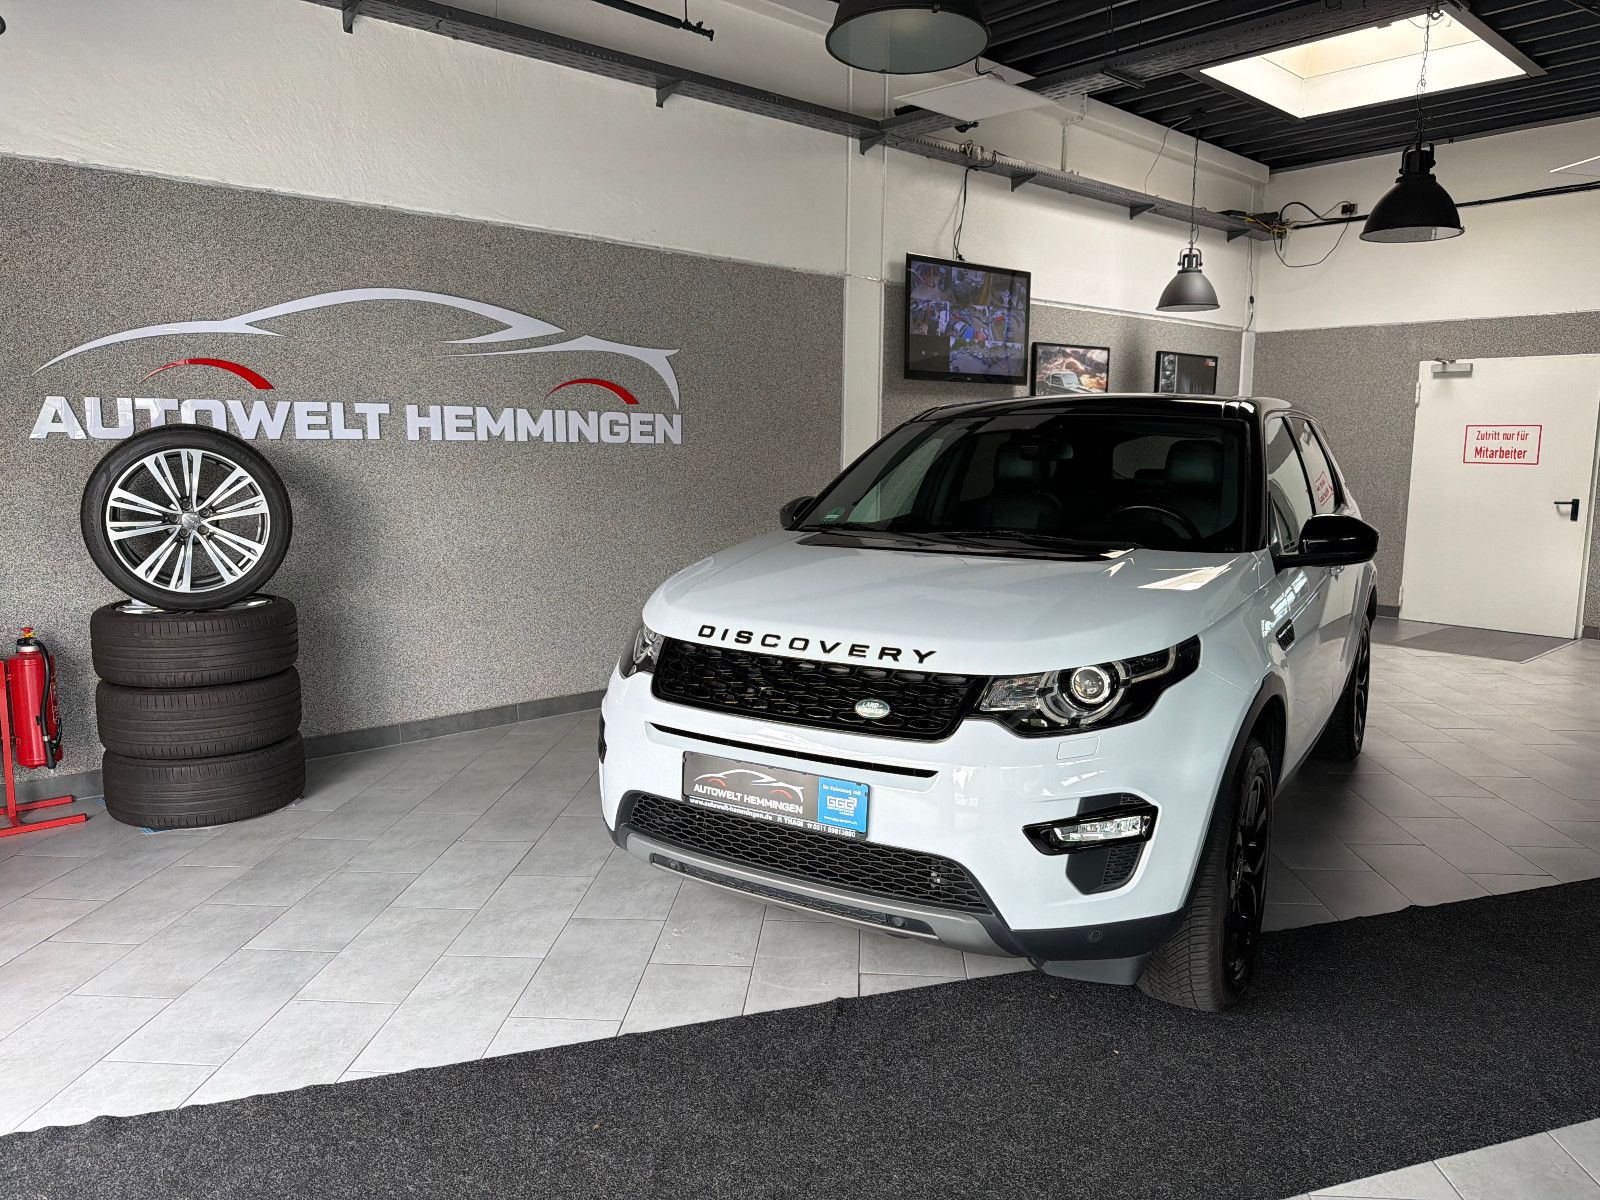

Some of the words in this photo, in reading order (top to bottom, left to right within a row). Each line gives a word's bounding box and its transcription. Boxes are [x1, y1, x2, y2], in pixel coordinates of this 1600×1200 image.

[28, 396, 390, 440] AUTOWELT
[405, 404, 682, 444] HEMMINGEN
[1476, 430, 1500, 441] Zutritt
[1502, 432, 1515, 441] nur
[1516, 430, 1530, 441] für
[1474, 446, 1528, 460] Mitarbeiter
[697, 624, 938, 664] DISCOVERY
[693, 784, 742, 801] AUTOWELT
[743, 795, 803, 814] HEMMINGEN
